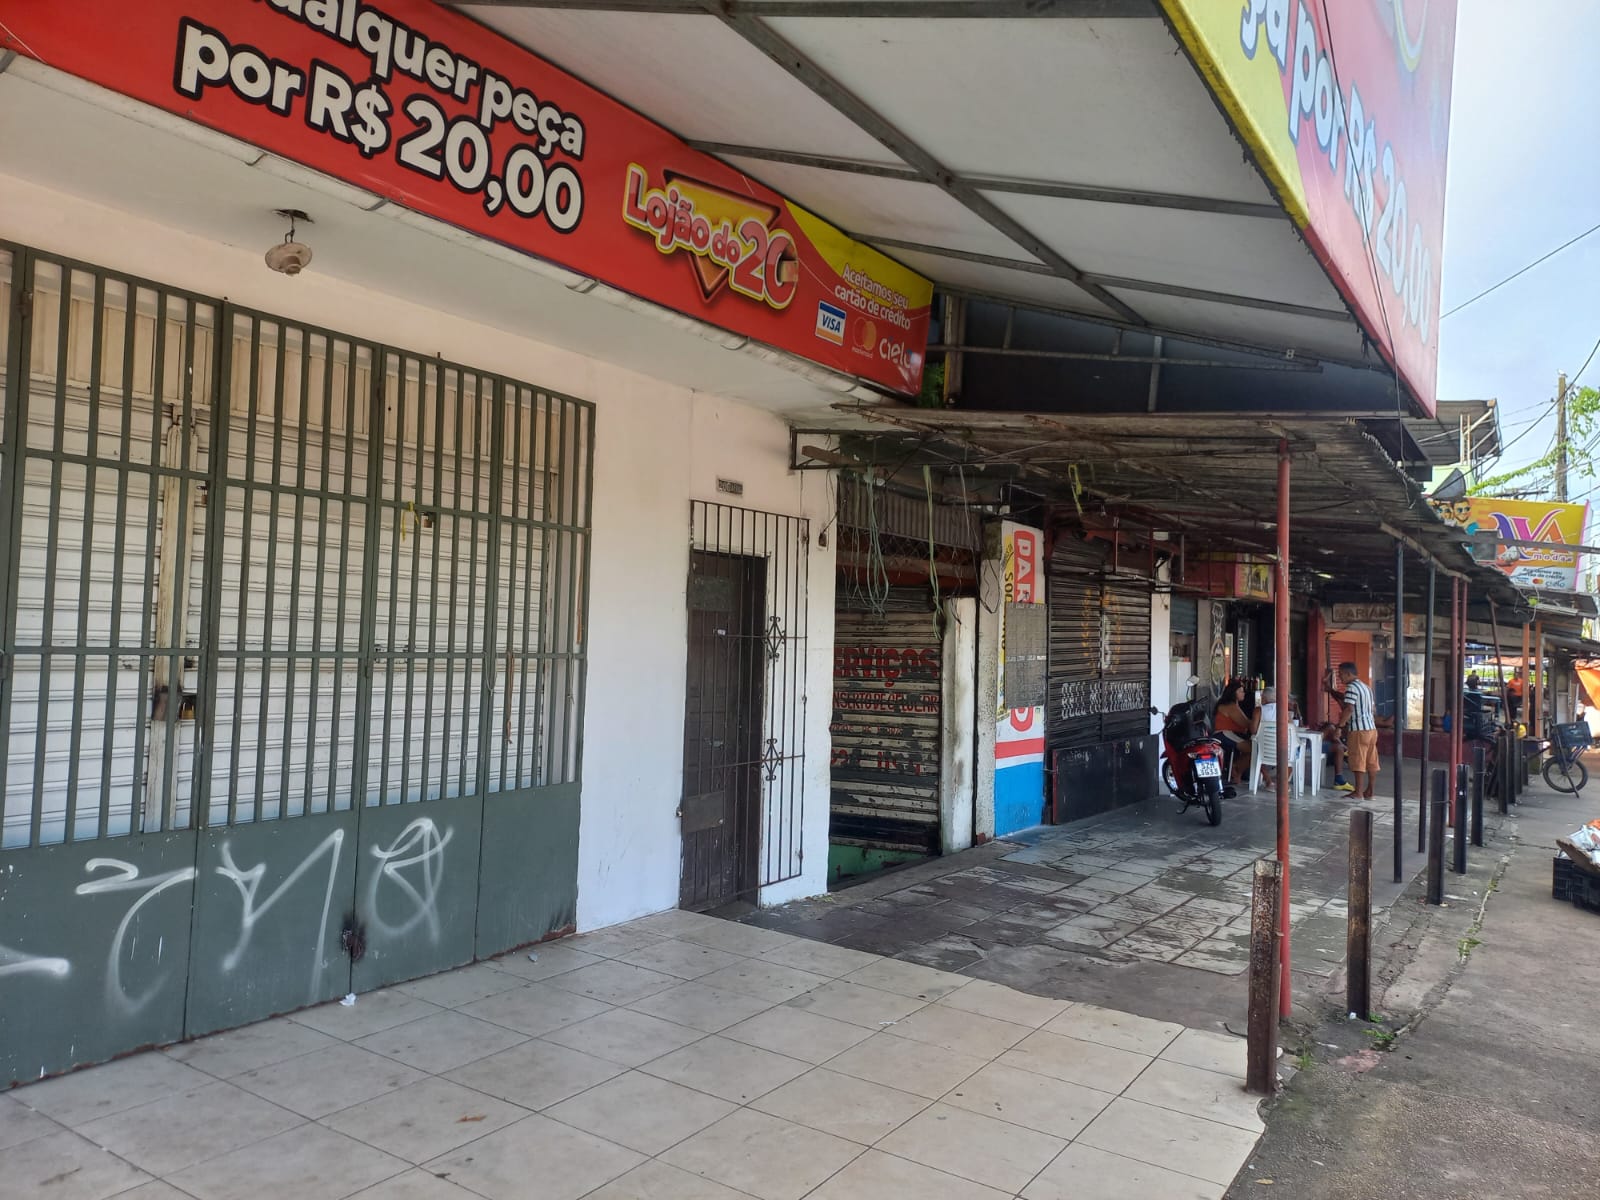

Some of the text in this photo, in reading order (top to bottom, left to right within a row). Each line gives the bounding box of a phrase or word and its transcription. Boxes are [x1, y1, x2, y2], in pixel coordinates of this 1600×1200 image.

[180, 25, 583, 231] por R$ 20,00
[481, 73, 584, 156] peça
[1289, 0, 1346, 169] por
[1376, 146, 1432, 345] 20,00
[622, 163, 711, 253] Lojão
[711, 219, 741, 265] do
[834, 285, 912, 331] cartão de crédito
[842, 263, 910, 310] Aceitamos seu
[822, 313, 841, 333] VISA
[834, 646, 939, 688] ERVIÇOS
